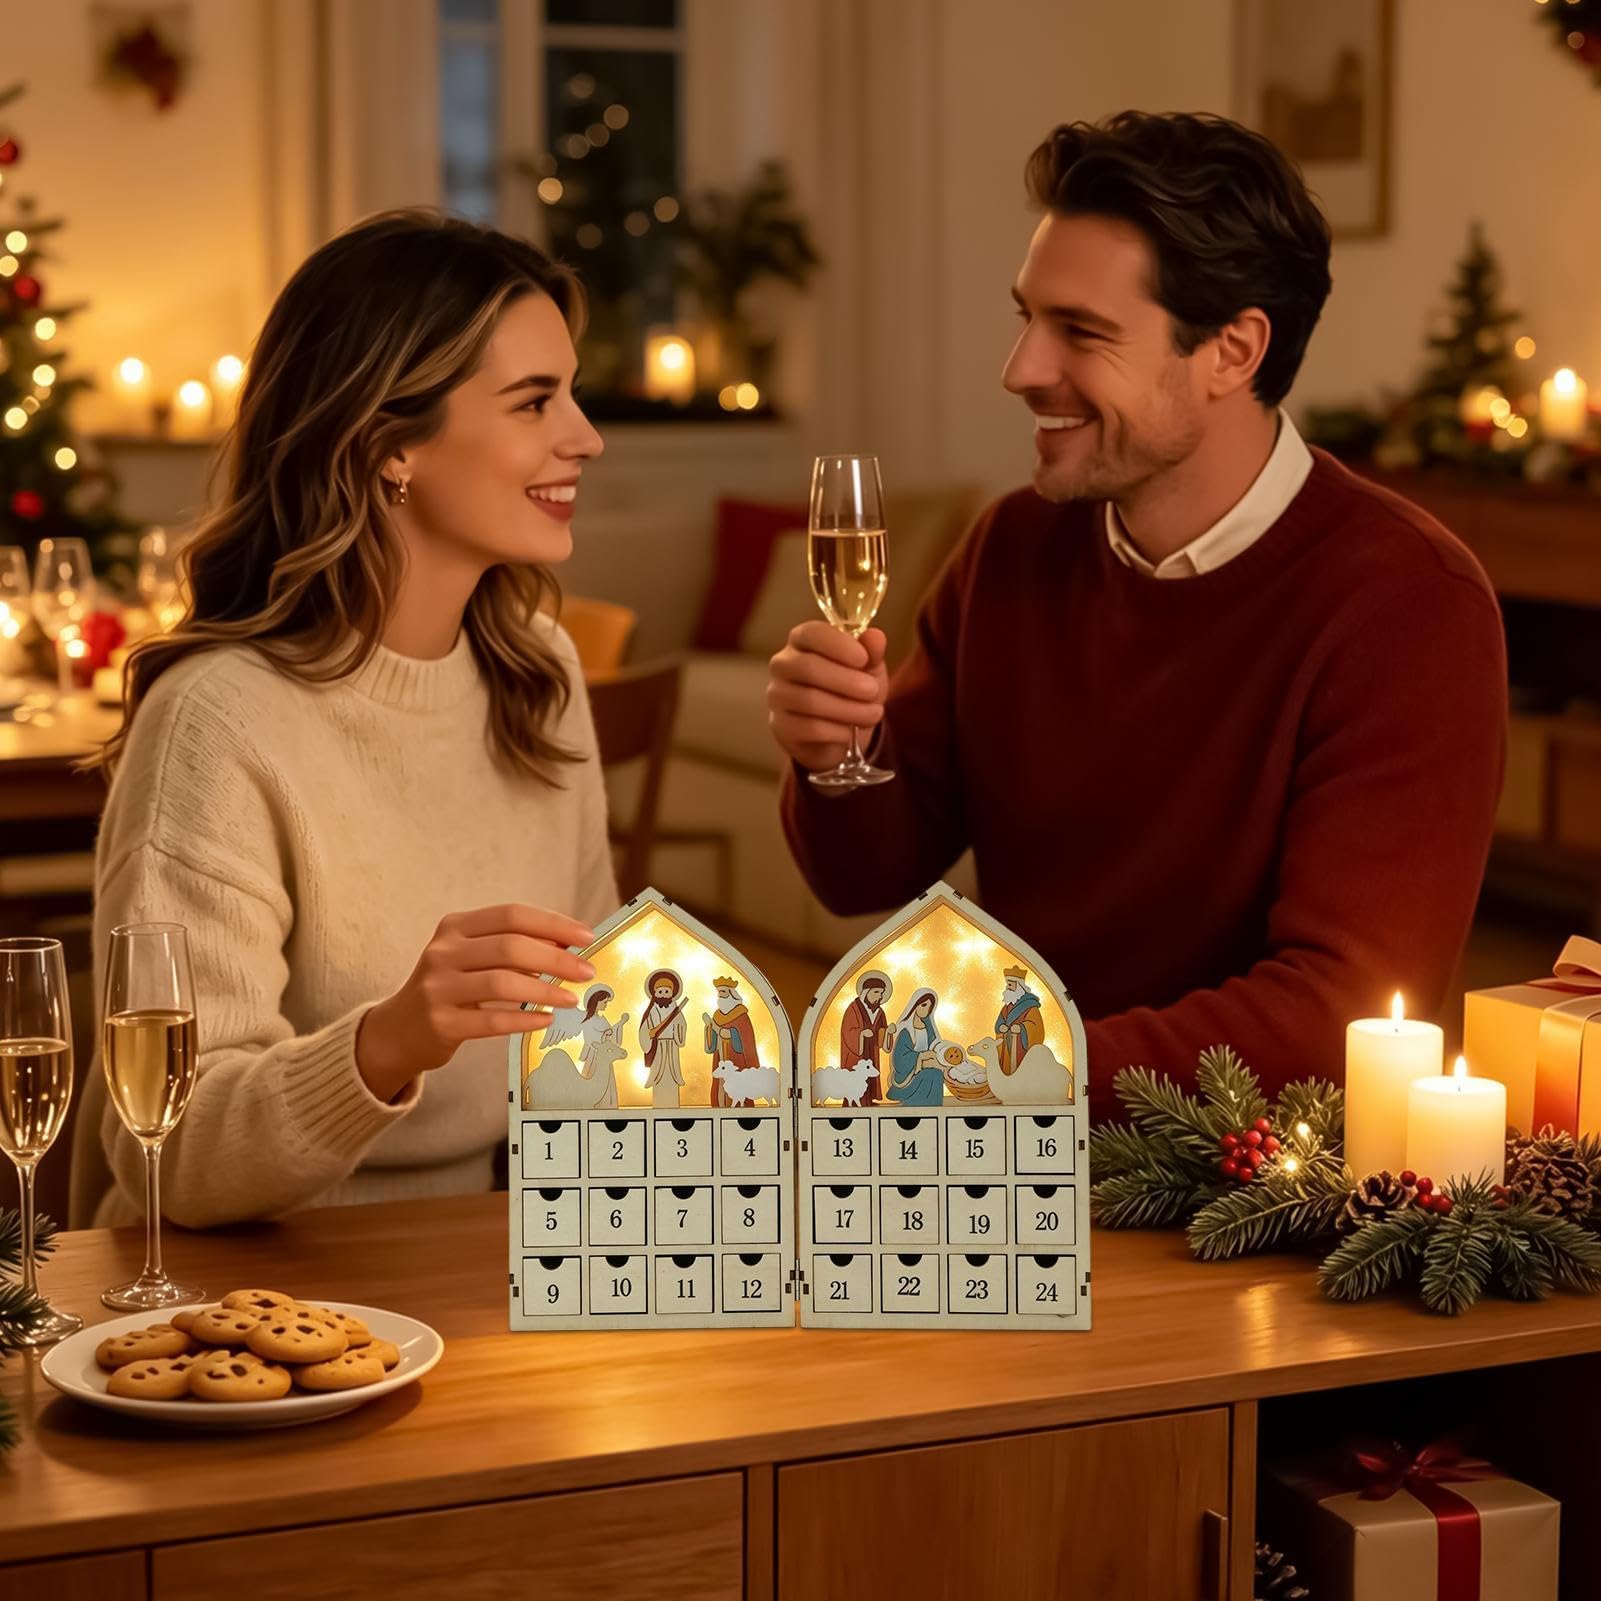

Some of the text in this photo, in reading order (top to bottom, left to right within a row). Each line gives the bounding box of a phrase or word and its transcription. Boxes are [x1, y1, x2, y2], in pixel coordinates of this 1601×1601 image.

[544, 1141, 554, 1161] 1
[611, 1141, 624, 1160] 2
[676, 1138, 689, 1158] 3
[743, 1137, 756, 1157] 4
[833, 1137, 854, 1158] 13
[898, 1139, 919, 1160] 14
[965, 1138, 985, 1159] 15
[1036, 1137, 1058, 1158] 16
[545, 1211, 558, 1231] 5
[609, 1209, 623, 1229] 6
[676, 1208, 689, 1229] 7
[742, 1207, 756, 1228] 8
[835, 1208, 855, 1229] 17
[902, 1210, 924, 1231] 18
[968, 1214, 991, 1235] 19
[1034, 1211, 1059, 1232] 20
[547, 1283, 560, 1304] 9
[611, 1277, 632, 1298] 10
[677, 1278, 697, 1299] 11
[741, 1279, 763, 1299] 12
[829, 1280, 851, 1301] 21
[896, 1275, 921, 1297] 22
[964, 1279, 989, 1300] 23
[1035, 1282, 1059, 1303] 24
